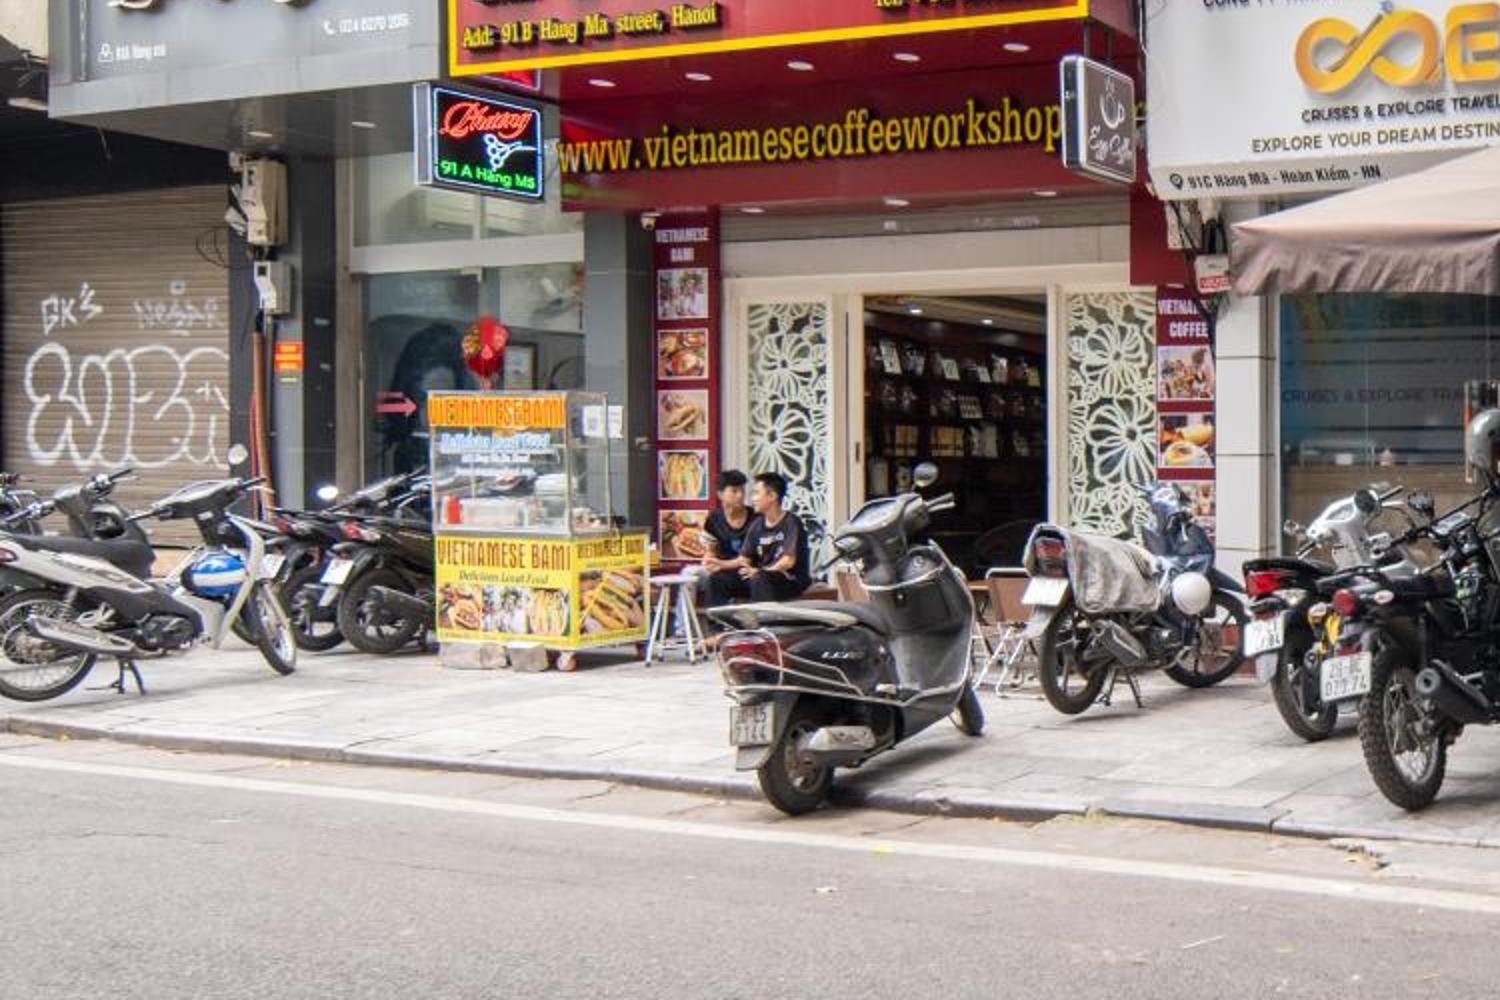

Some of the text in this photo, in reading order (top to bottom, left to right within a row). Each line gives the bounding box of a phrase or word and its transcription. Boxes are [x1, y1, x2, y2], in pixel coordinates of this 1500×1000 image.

[463, 26, 495, 48] Add:
[540, 18, 578, 43] Hang
[584, 13, 609, 36] Ma
[616, 10, 663, 33] street,
[671, 2, 718, 27] Hanoi
[1301, 104, 1359, 124] CRUISES
[1363, 104, 1374, 118] &
[1377, 97, 1446, 119] EXPLORE
[1252, 134, 1322, 154] EXPLORE
[1328, 129, 1373, 149] YOUR
[1377, 124, 1437, 146] DREAM
[440, 160, 457, 176] 91
[461, 166, 473, 178] A
[1360, 164, 1381, 179] HN
[1169, 321, 1209, 339] COFFEE
[437, 540, 572, 571] VIETNAMESE BAMI
